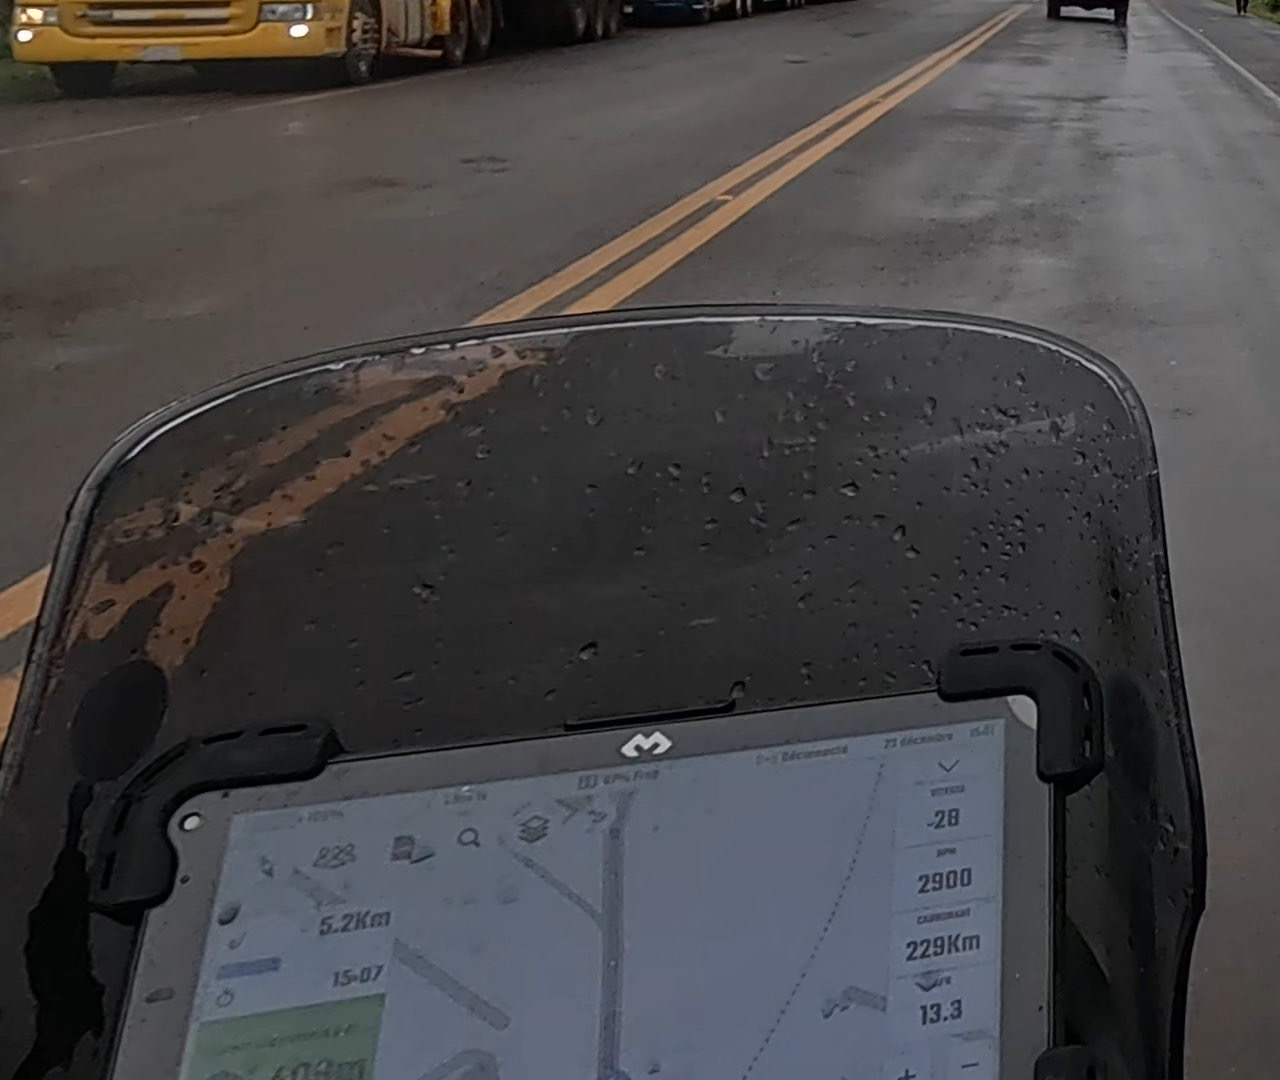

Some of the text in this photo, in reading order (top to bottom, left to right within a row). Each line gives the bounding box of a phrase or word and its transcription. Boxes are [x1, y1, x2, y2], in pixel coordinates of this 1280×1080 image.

[918, 867, 972, 895] 2900
[319, 911, 391, 936] 5.2Km
[905, 933, 981, 962] 229Km
[920, 999, 963, 1025] 13.3
